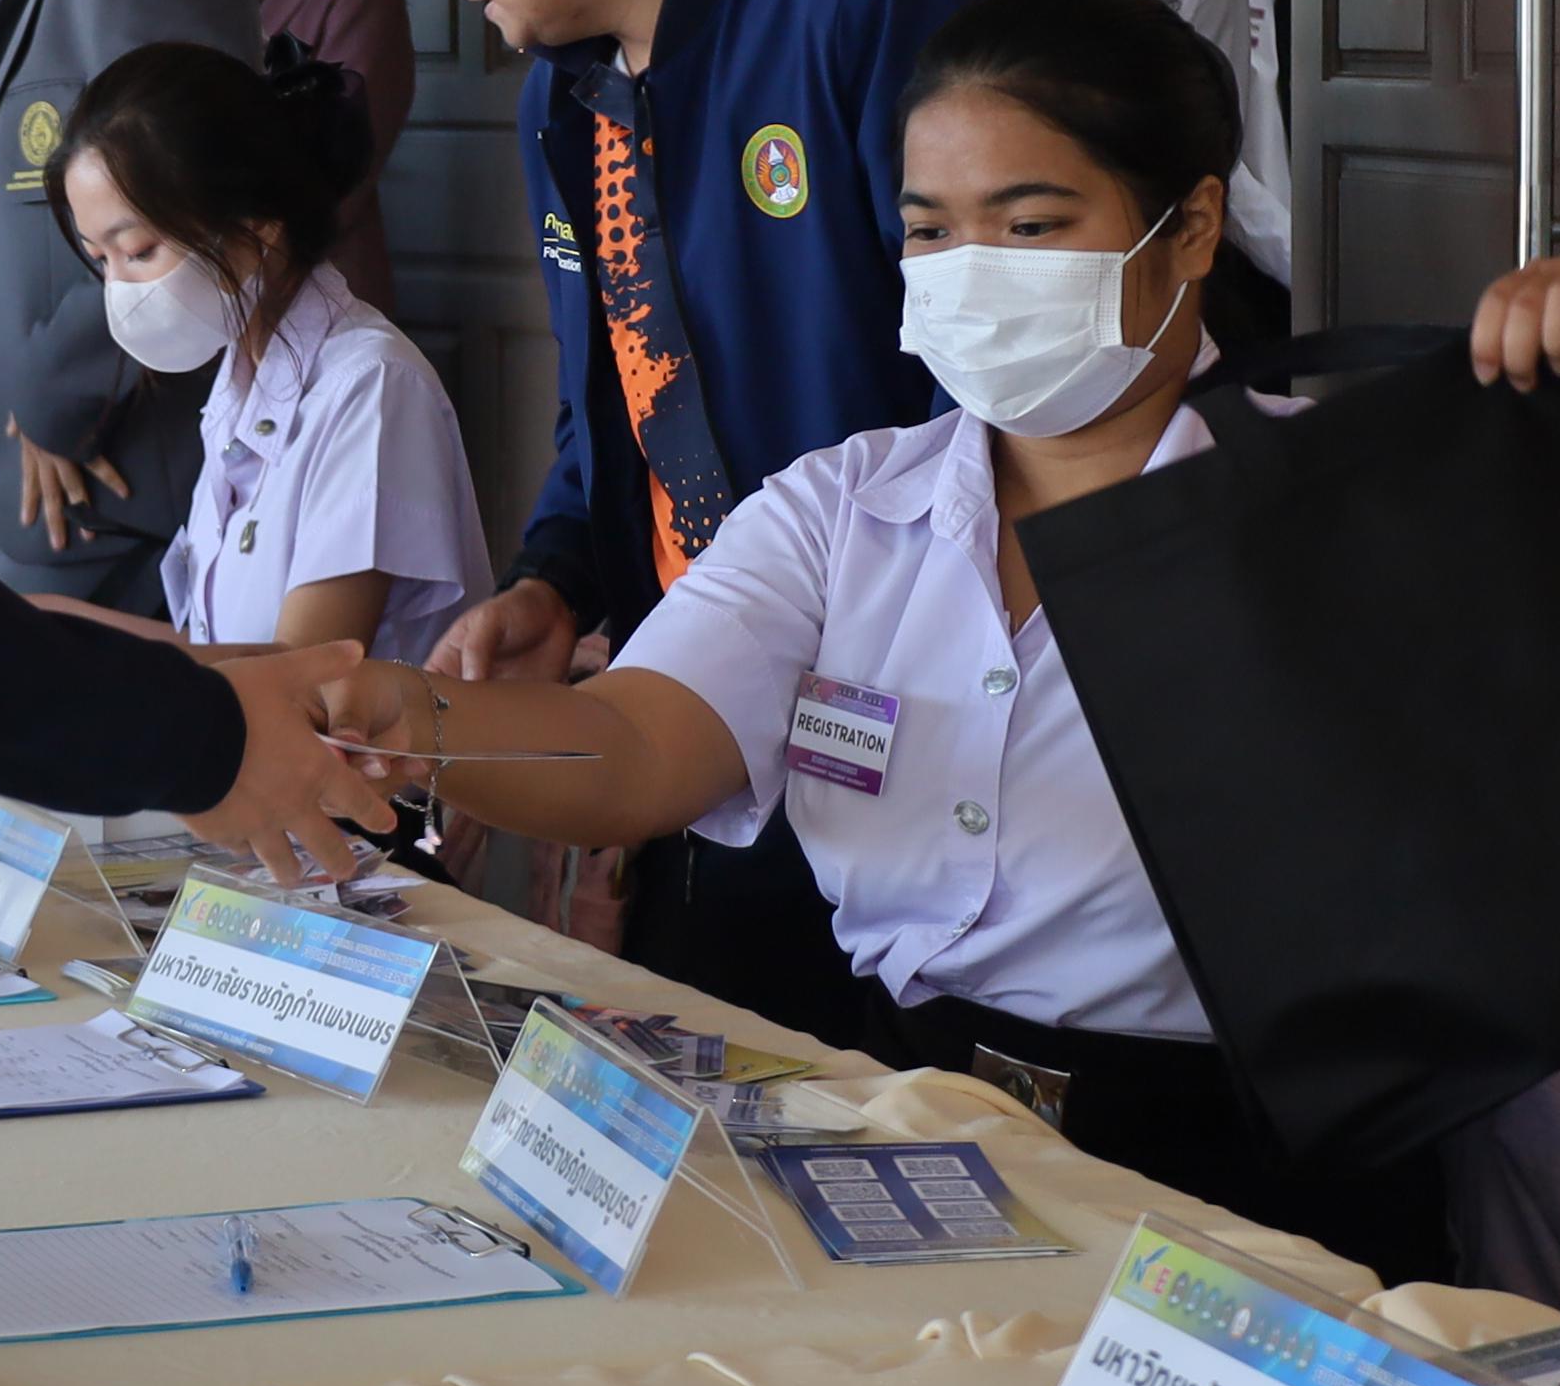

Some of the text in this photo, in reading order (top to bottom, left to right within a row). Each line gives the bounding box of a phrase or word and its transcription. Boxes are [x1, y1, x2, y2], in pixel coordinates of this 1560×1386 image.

[796, 712, 887, 754] REGISTRATION
[149, 949, 396, 1046] มหาวิทยาลัยราชภัฏกำแพงเพชร
